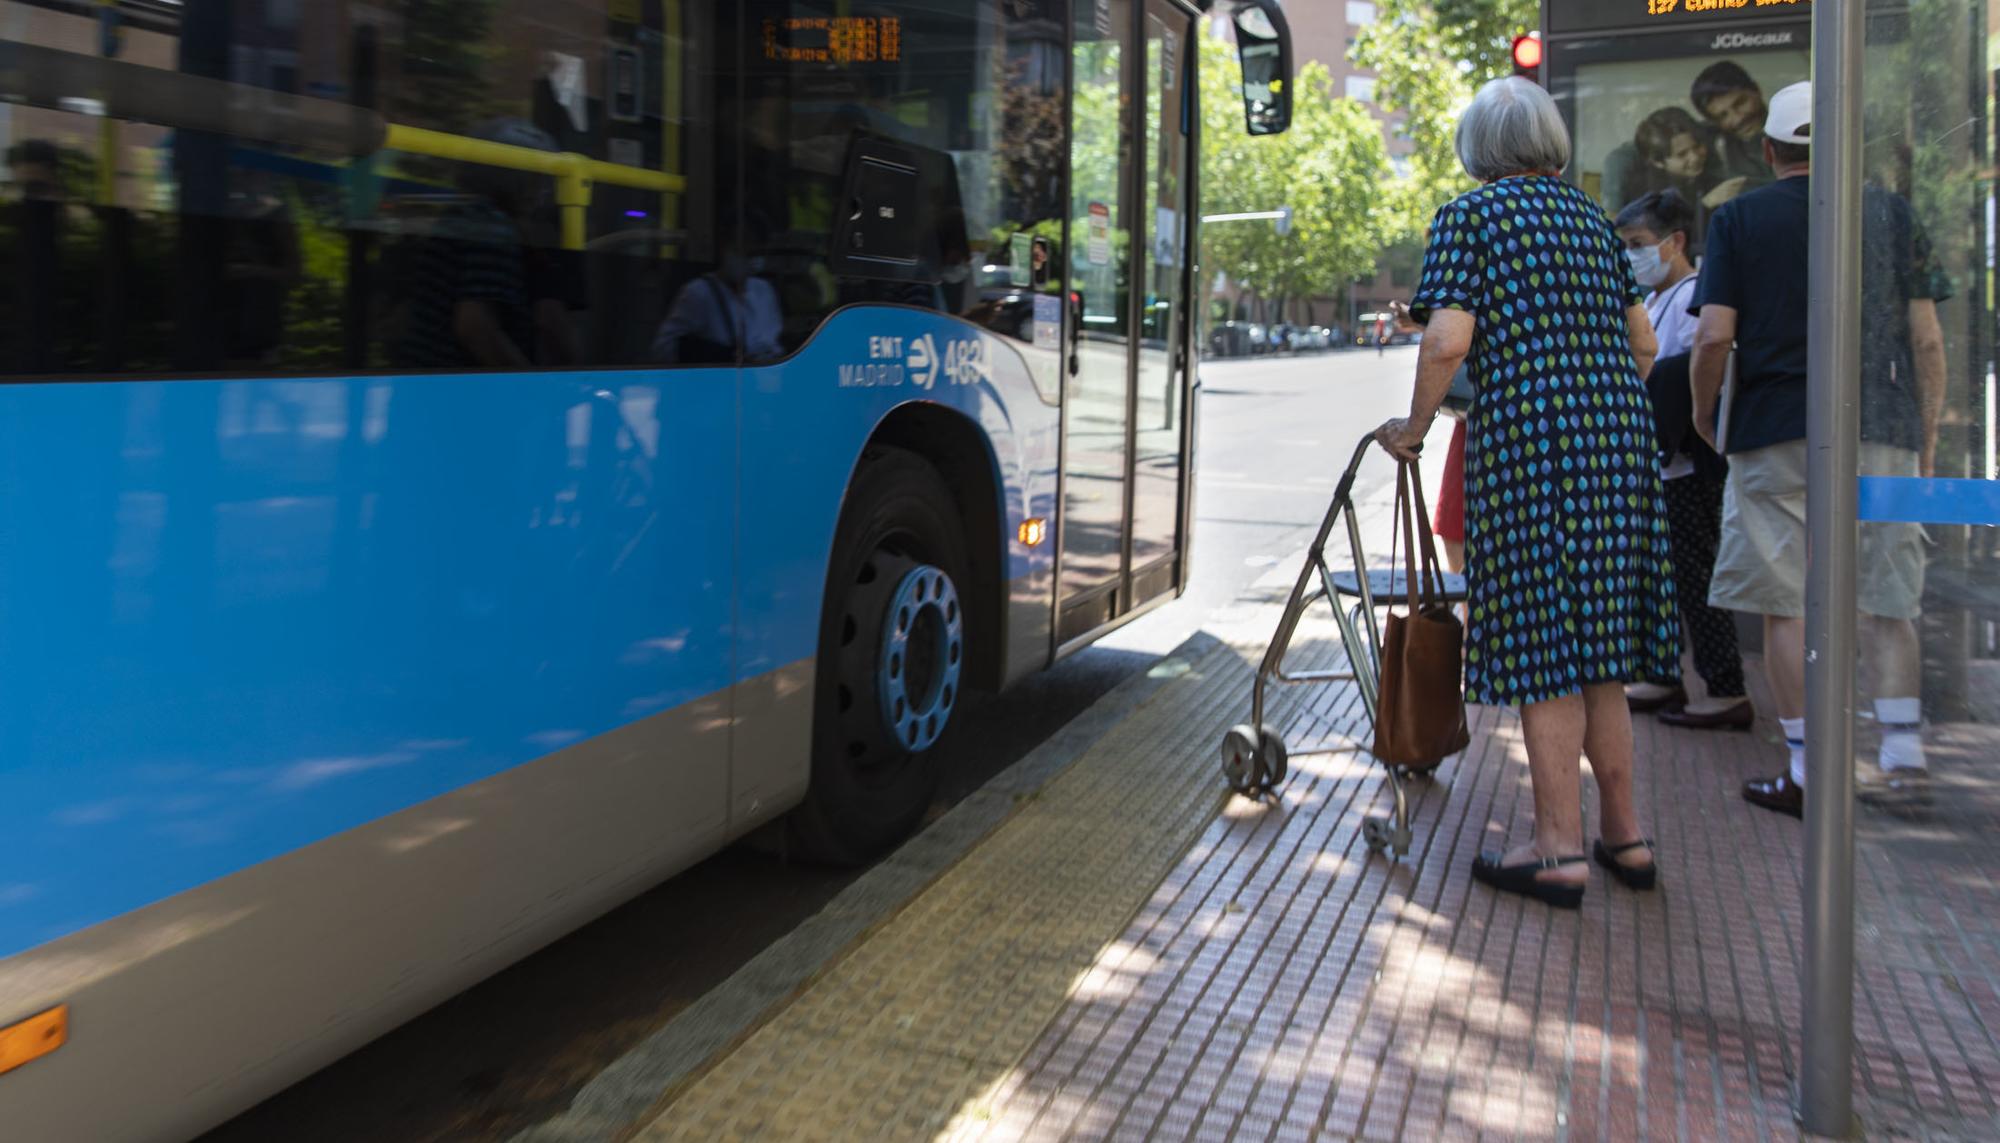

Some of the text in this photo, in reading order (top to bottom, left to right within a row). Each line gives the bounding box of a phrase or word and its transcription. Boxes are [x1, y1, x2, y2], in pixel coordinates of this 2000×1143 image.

[1711, 32, 1792, 49] JCDecaux
[869, 336, 903, 358] EMT
[838, 364, 904, 387] MADRID
